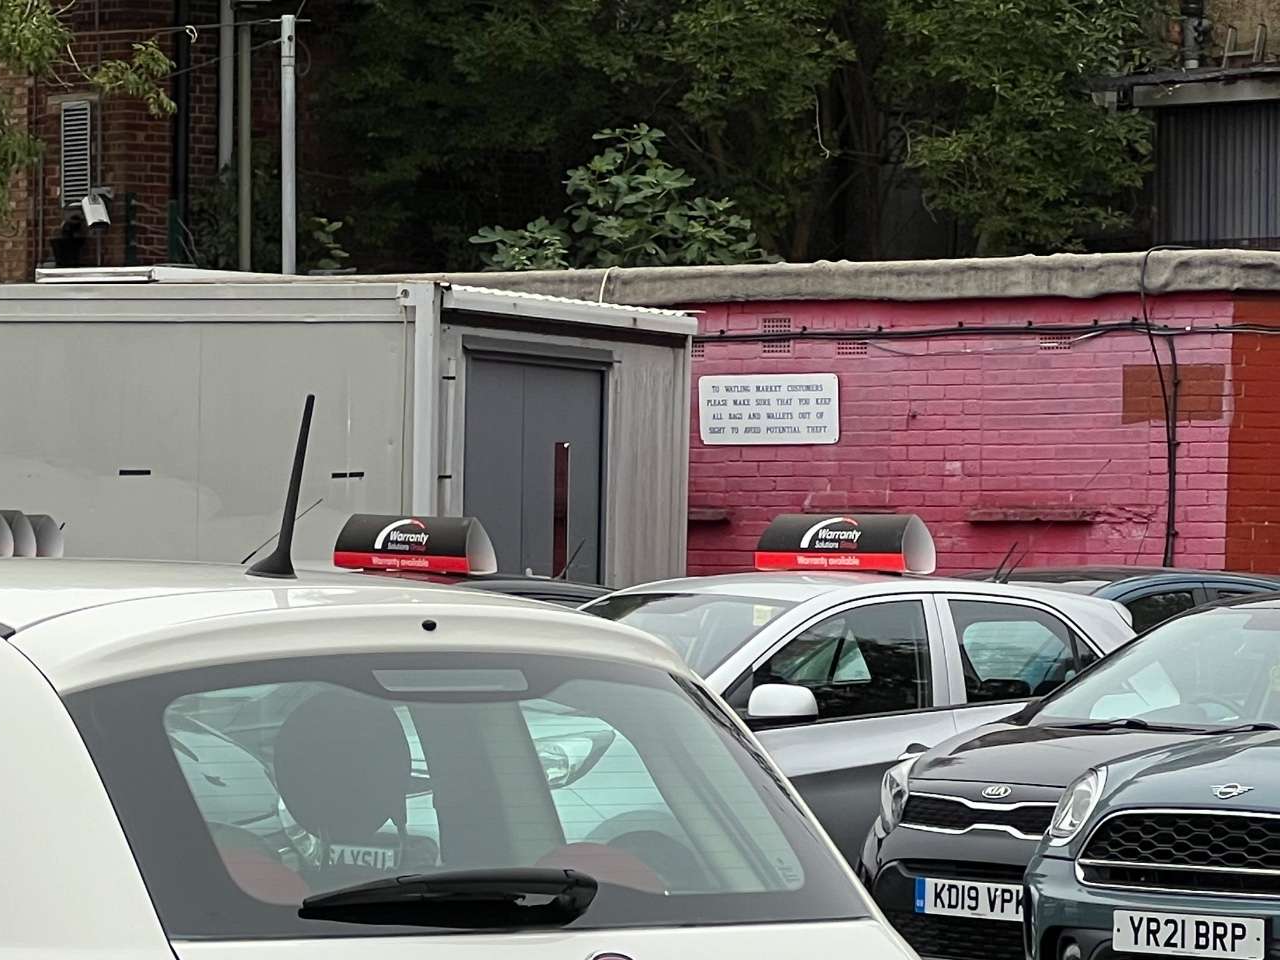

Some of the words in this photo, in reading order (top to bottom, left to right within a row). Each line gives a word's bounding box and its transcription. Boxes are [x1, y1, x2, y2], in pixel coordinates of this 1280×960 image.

[711, 385, 720, 393] TO
[724, 385, 751, 393] WATLING
[786, 384, 823, 392] CUSTOMERS
[748, 412, 761, 420] AND
[766, 412, 793, 420] WALLETS
[708, 426, 725, 434] SIGHT
[731, 426, 739, 434] TO
[744, 426, 761, 434] AVOID
[766, 426, 800, 434] POTENTIAL
[806, 425, 827, 433] THEFT
[390, 531, 429, 545] Warranty
[818, 528, 861, 543] Warranty
[815, 540, 839, 549] Solutions
[796, 555, 828, 567] Warranty
[828, 556, 860, 566] available
[984, 786, 1006, 796] KIA
[933, 882, 979, 911] KD19
[1129, 915, 1185, 949] YR21
[1194, 920, 1247, 952] BRP
